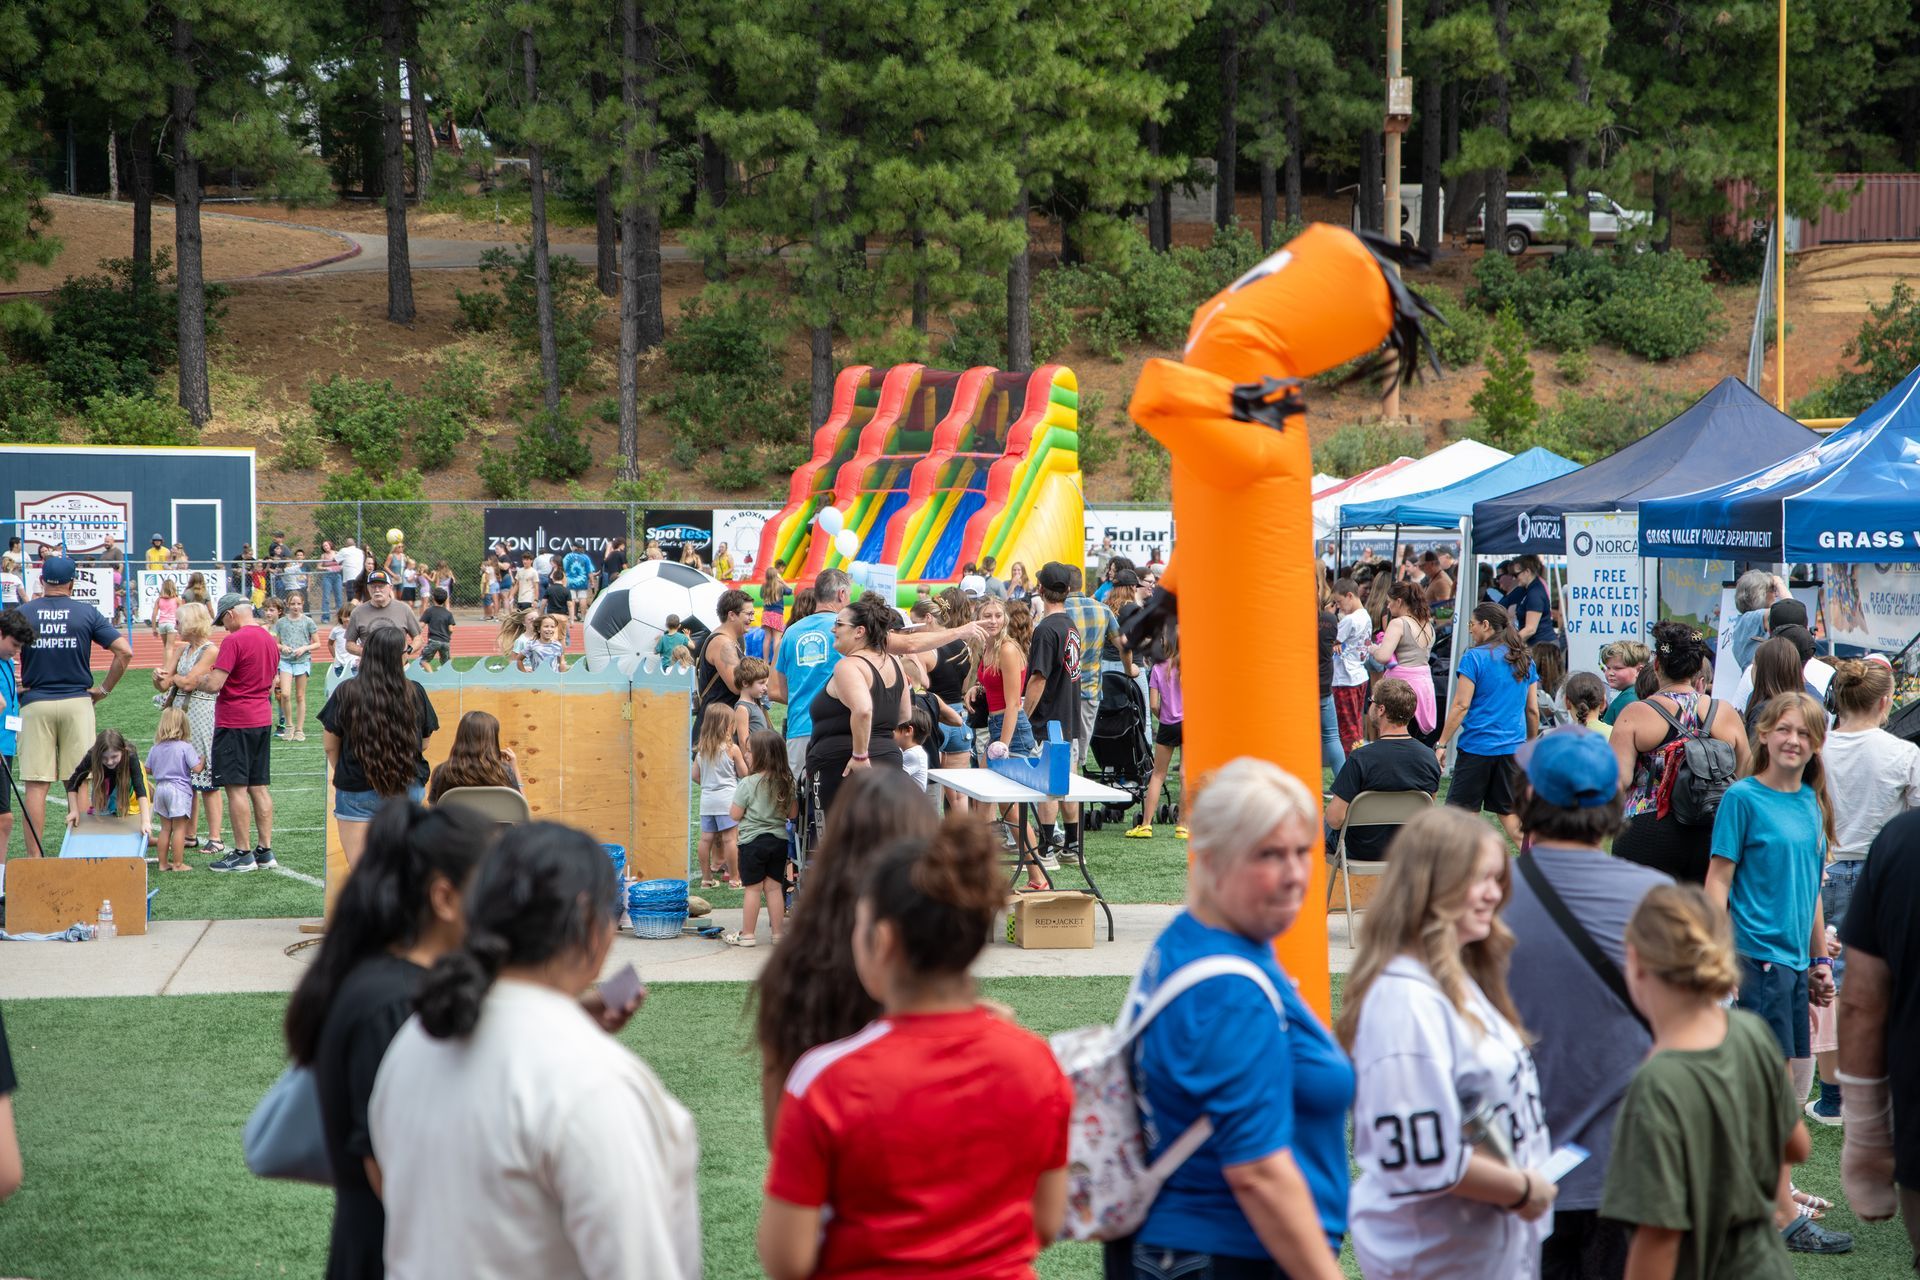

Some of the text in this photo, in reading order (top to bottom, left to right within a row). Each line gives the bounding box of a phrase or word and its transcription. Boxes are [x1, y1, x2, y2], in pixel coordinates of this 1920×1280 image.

[31, 514, 118, 530] CASEYWOOD
[738, 511, 769, 524] BOXIN
[645, 527, 711, 541] Spotless
[1104, 526, 1169, 542] Solar
[1529, 521, 1561, 540] NORCAL
[549, 537, 617, 551] CAPITA
[1645, 529, 1773, 548] GRASS VALLEY POLICE DEPARTMENT
[1819, 531, 1905, 549] GRASS
[1595, 539, 1638, 553] NORCA
[159, 573, 218, 585] YOUGS
[1594, 569, 1627, 583] FREE
[37, 609, 70, 621] TRUST
[1579, 603, 1640, 617] FOR KIDS
[1872, 603, 1892, 616] YOUR
[1894, 604, 1920, 617] COMMU
[40, 623, 67, 634] LOVE
[1568, 620, 1655, 635] OF ALL AGS
[1374, 1110, 1446, 1170] 30
